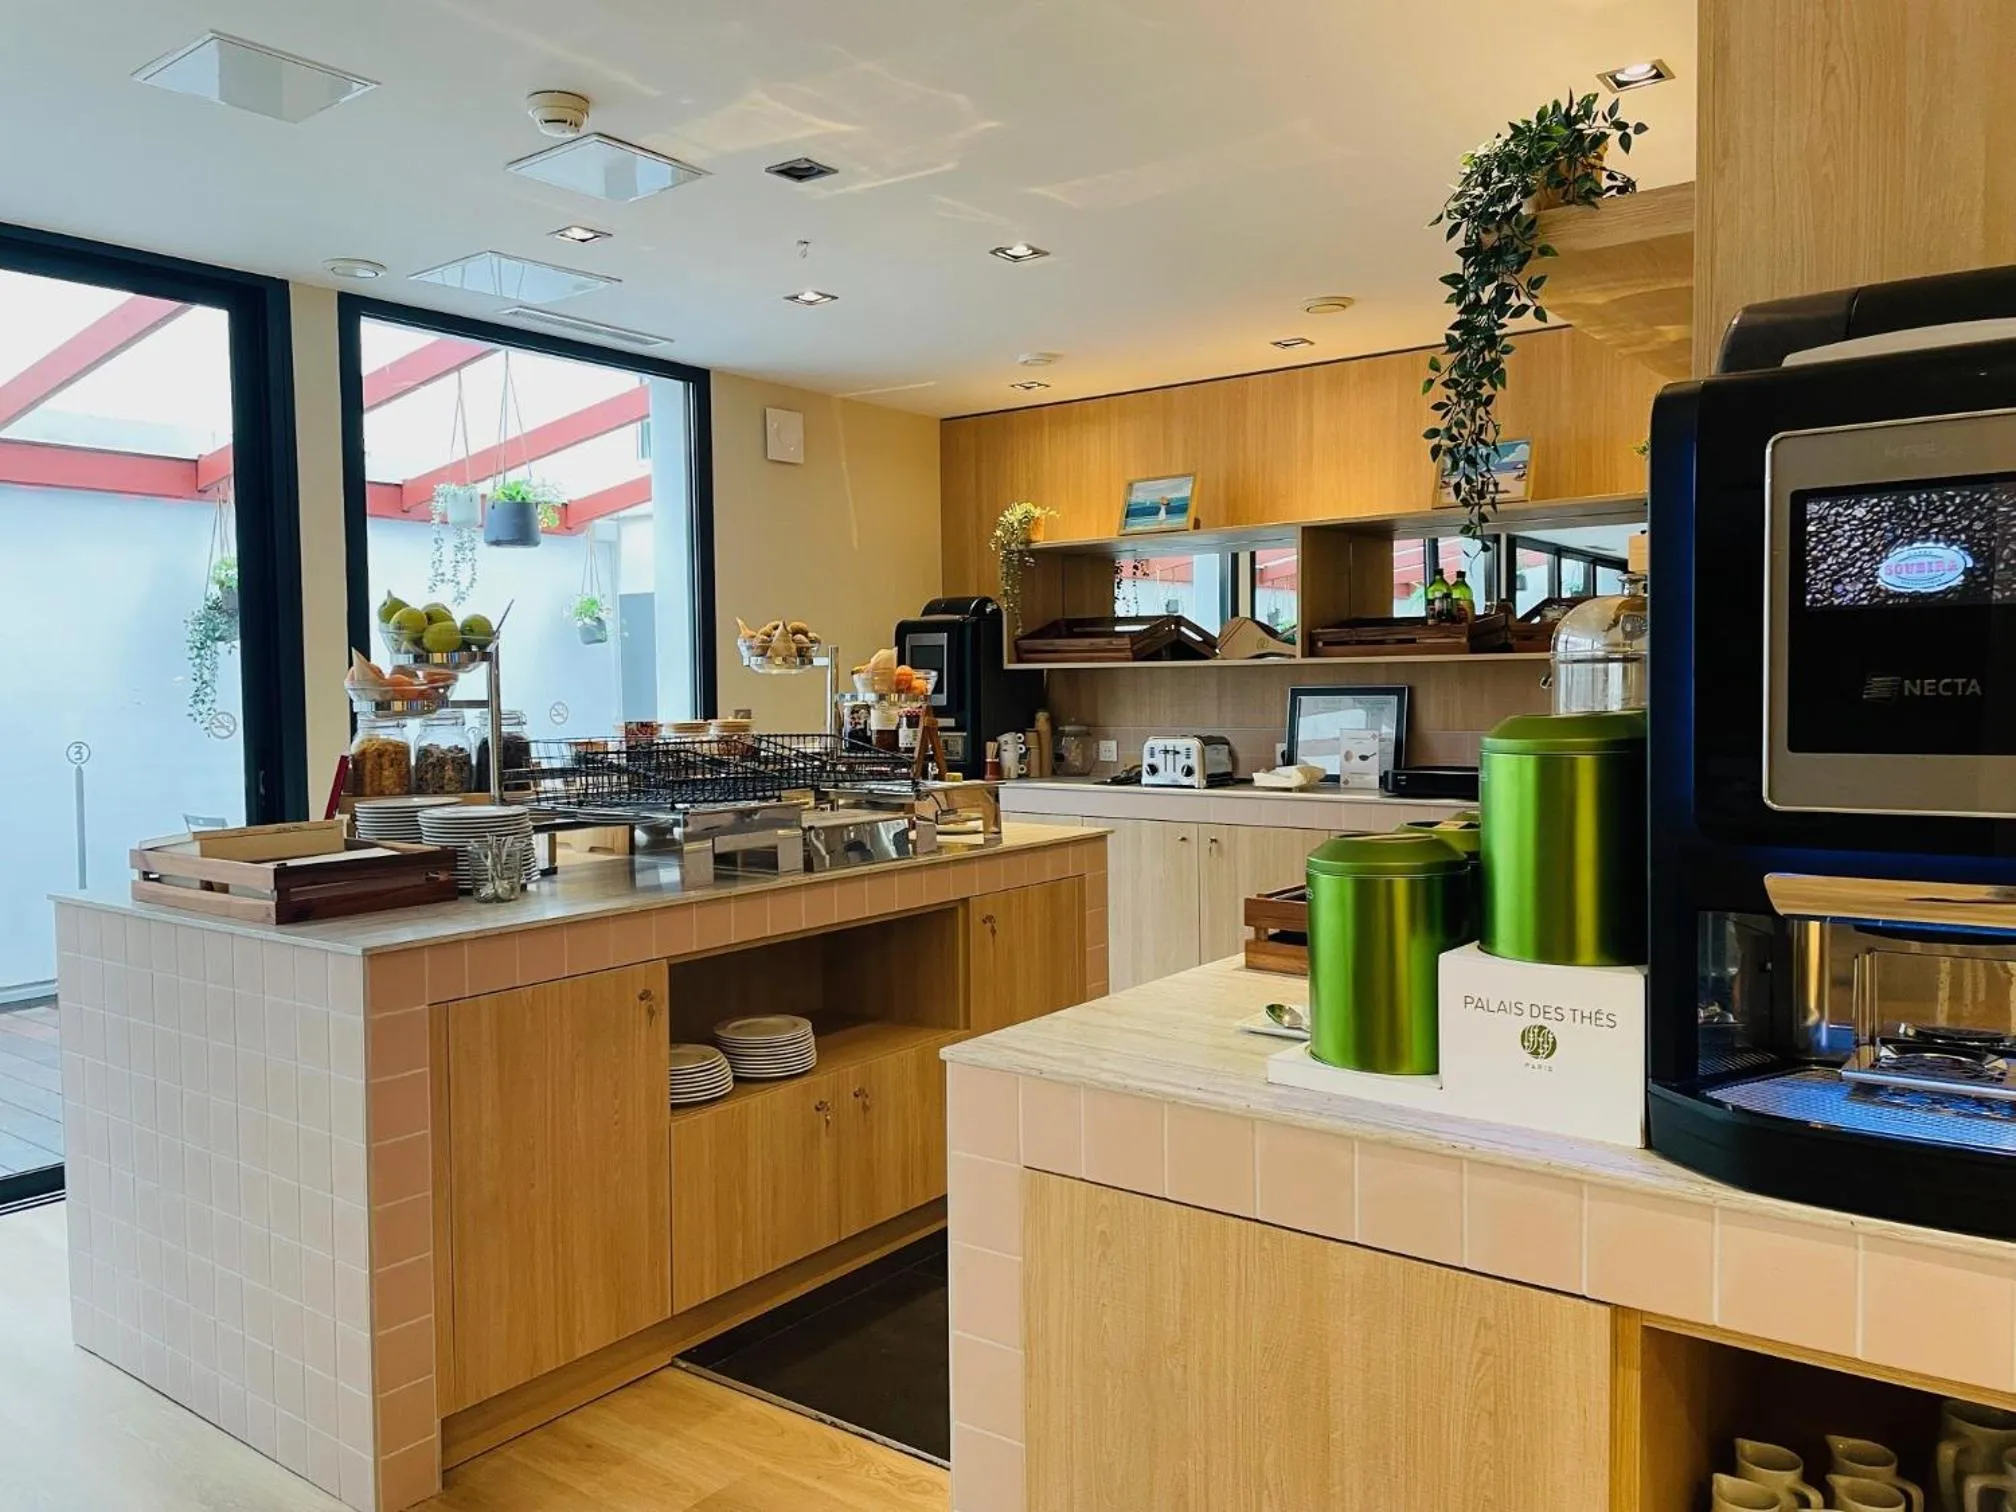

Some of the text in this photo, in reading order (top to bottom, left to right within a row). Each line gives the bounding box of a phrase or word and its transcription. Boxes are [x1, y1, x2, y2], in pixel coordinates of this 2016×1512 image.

[1904, 679, 1982, 697] NECTA
[1463, 995, 1618, 1029] PALAIS DES THÉS
